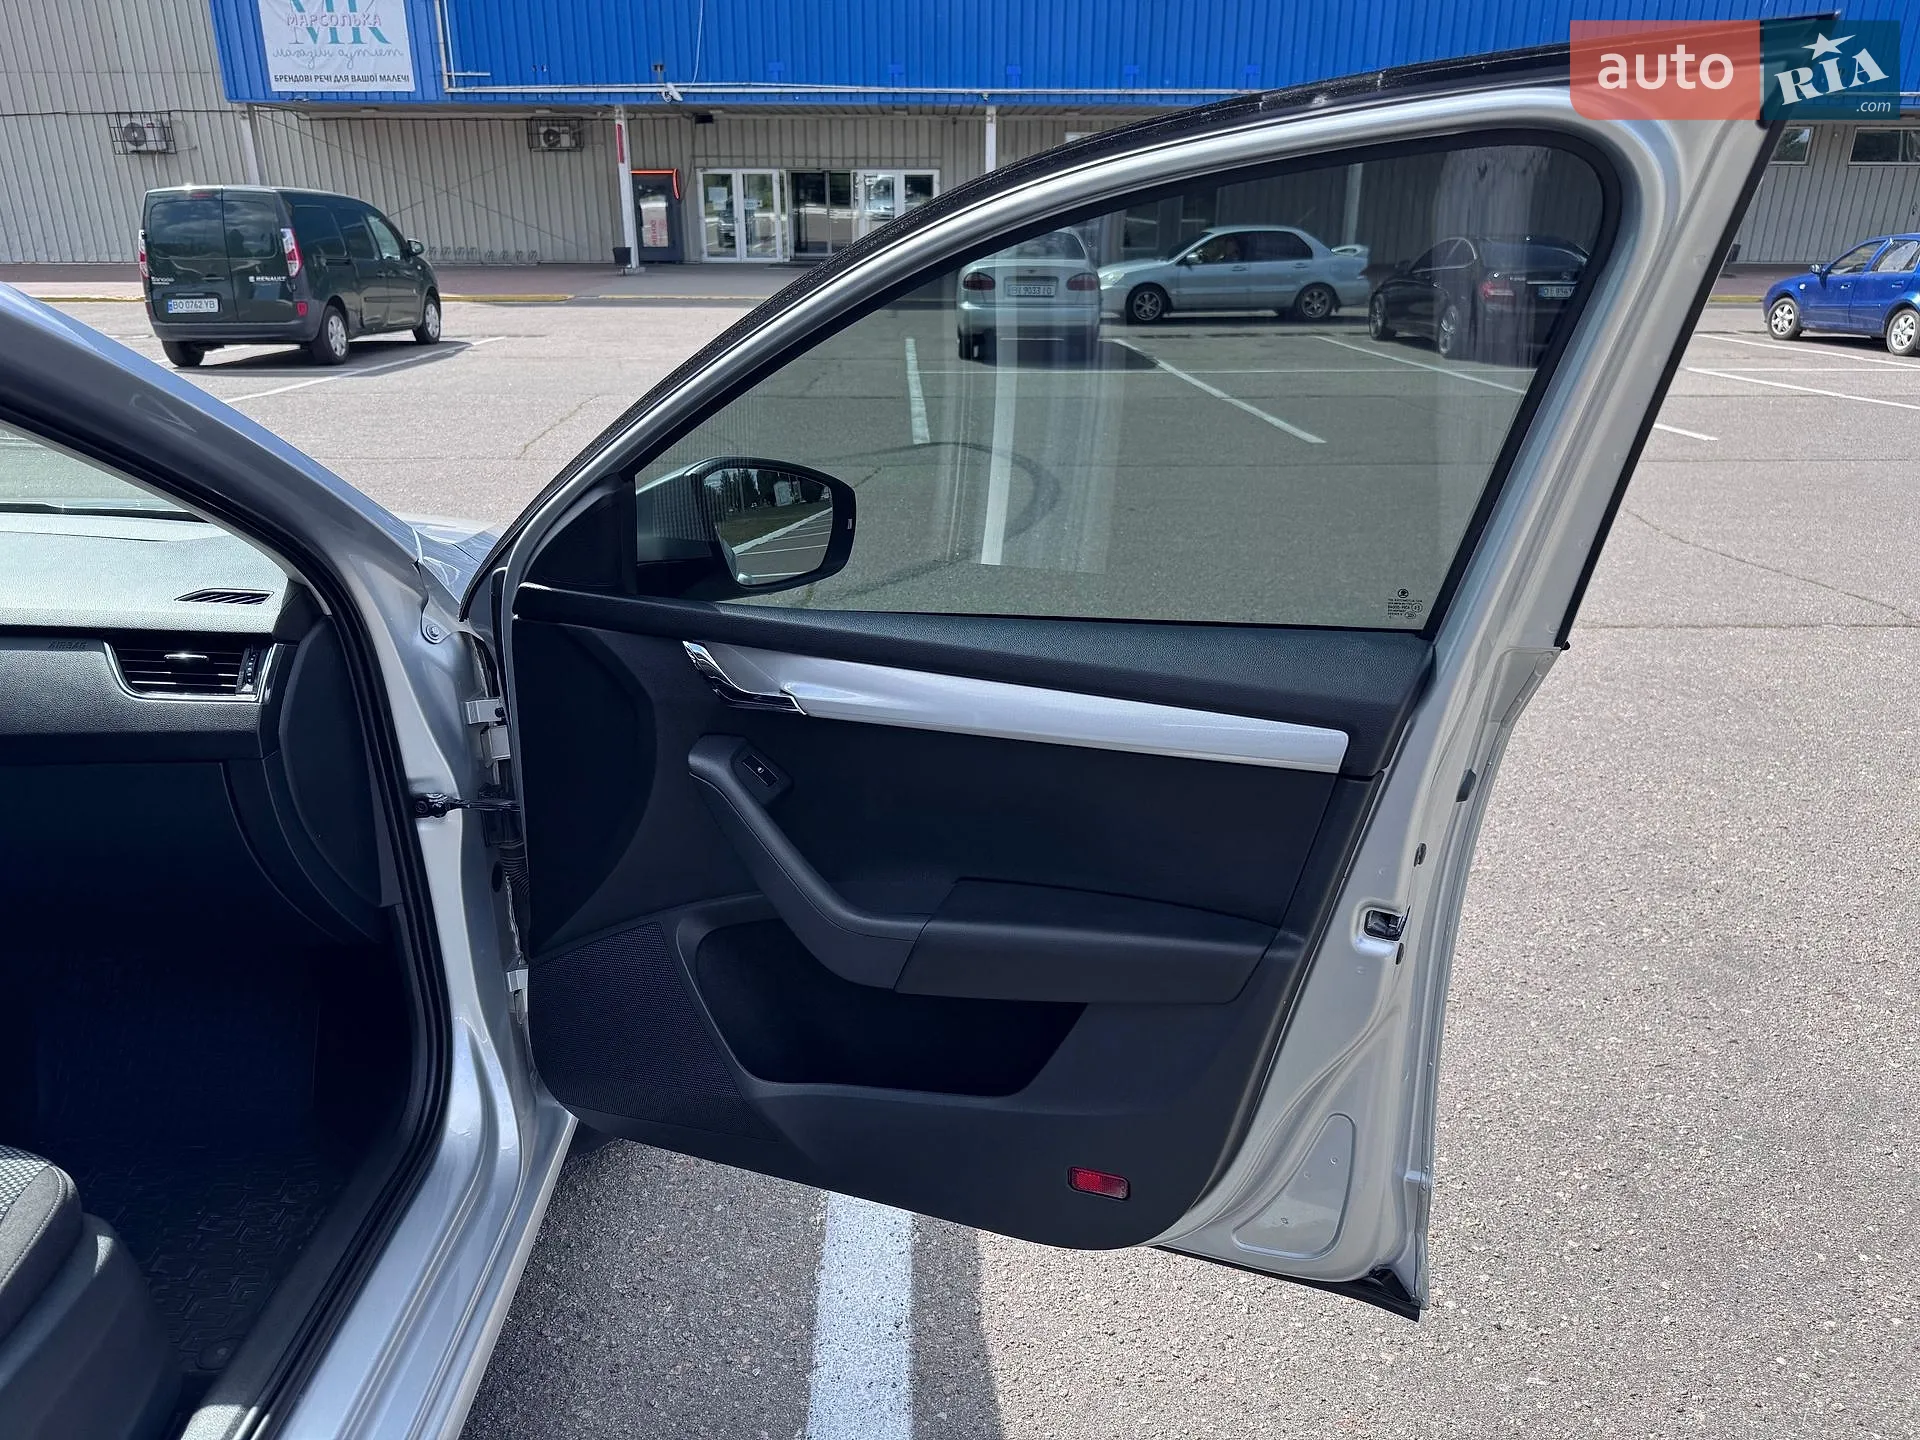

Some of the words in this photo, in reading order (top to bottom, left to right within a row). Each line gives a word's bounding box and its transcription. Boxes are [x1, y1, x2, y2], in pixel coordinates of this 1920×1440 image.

[287, 13, 382, 27] МАРСОЛЬКА
[274, 74, 313, 83] БРЕНДОВІ
[314, 74, 333, 83] РЕЧІ
[333, 74, 350, 83] ДЛЯ
[351, 73, 378, 83] ВАШОЇ
[379, 74, 410, 83] МАЛЕЧІ
[173, 301, 184, 310] BO
